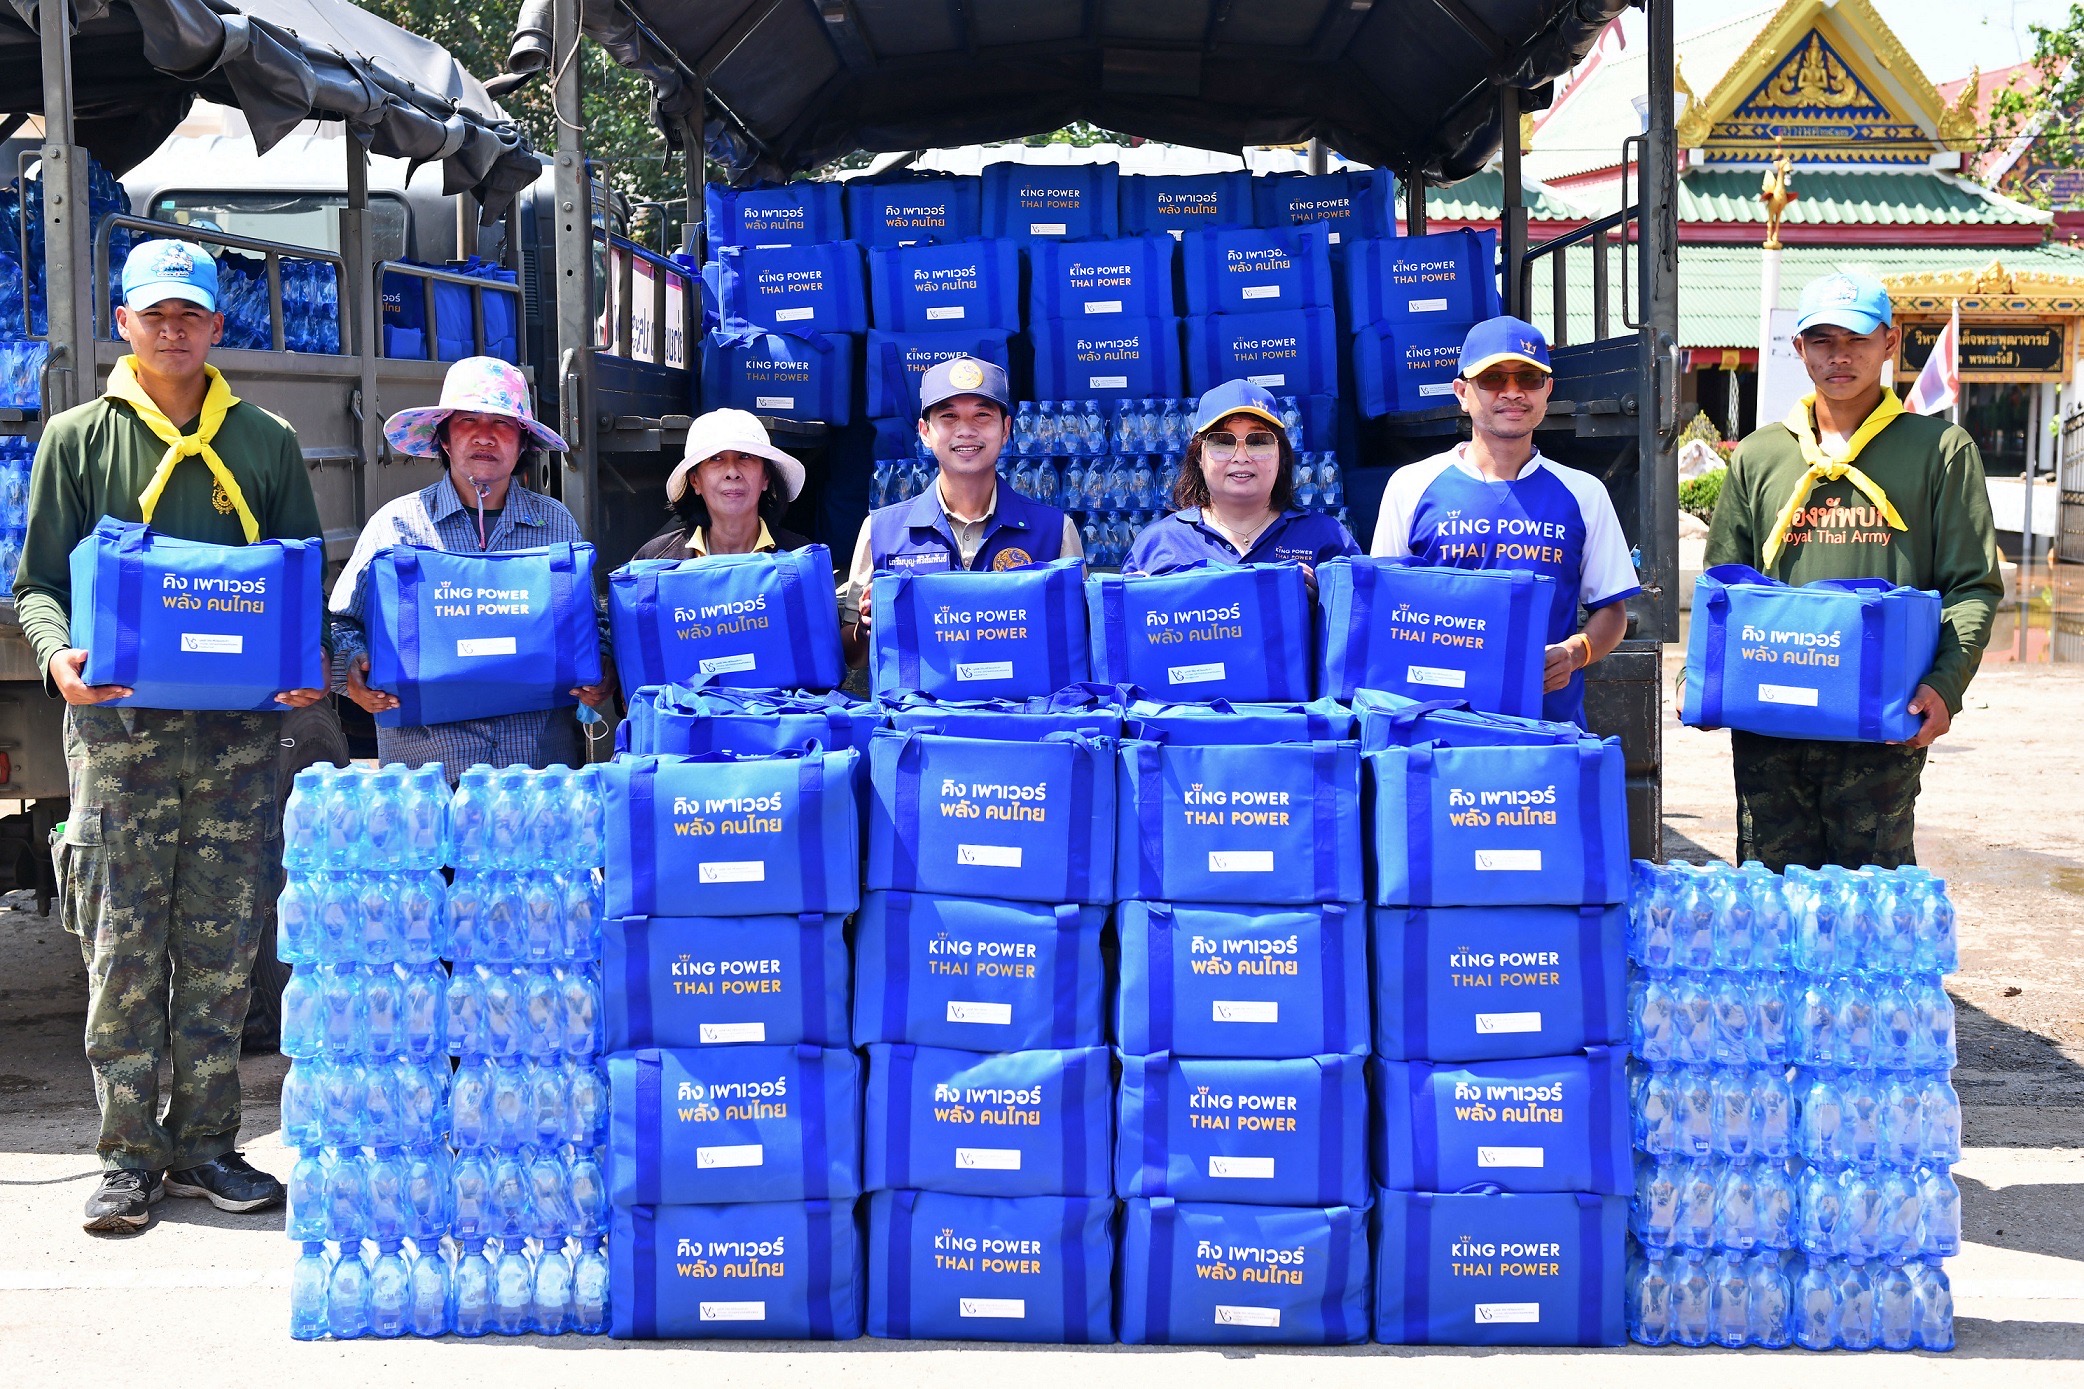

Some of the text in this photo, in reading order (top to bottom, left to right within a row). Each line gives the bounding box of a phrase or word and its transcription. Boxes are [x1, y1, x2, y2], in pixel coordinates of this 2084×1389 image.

[1159, 192, 1217, 202] คิง เพาเวอร์
[745, 207, 803, 217] คิง เพาเวอร์
[886, 205, 944, 215] คิง เพาเวอร์
[1158, 203, 1216, 214] พลัง คนไทย
[745, 219, 803, 229] พลัง คนไทย
[886, 216, 944, 226] พลัง คนไทย
[1228, 249, 1287, 260] คิง เพาเวอ
[914, 265, 976, 280] คิง เพาเวอร์
[1070, 266, 1131, 276] KING POWER
[1229, 259, 1290, 272] พลัง คนไทย
[1393, 261, 1455, 272] KING POWER
[759, 271, 822, 282] KING POWER
[1071, 278, 1131, 287] THAI POWER
[1394, 273, 1455, 284] THAI POWER
[760, 283, 822, 294] THAI POWER
[915, 279, 976, 291] พลัง คนไทย
[1077, 337, 1138, 349] คิง เพาเวอร์
[1233, 338, 1296, 350] KING POWER
[1078, 349, 1139, 361] พลัง คนไทย
[1235, 350, 1296, 361] THAI POWER
[1438, 518, 1566, 540] KING POWER
[1816, 530, 1846, 544] Thai
[1851, 530, 1891, 546] Army
[1439, 543, 1563, 564] THAI POWER
[163, 573, 265, 594] คิง เพาเวอร์
[163, 593, 264, 613] พลัง คนไทย
[435, 589, 529, 602] KING POWER
[434, 603, 529, 616] THAI POWER
[675, 593, 766, 622] คิง เพาเวอร์
[1147, 603, 1240, 626] คิง เพาเวอร์
[934, 609, 1026, 624] KING POWER
[1392, 610, 1486, 630] KING POWER
[677, 616, 768, 640] พลัง คนไทย
[935, 628, 1027, 642] THAI POWER
[1148, 623, 1241, 644] พลัง คนไทย
[1742, 625, 1841, 647] คิง เพาเวอร์
[1391, 628, 1483, 649] THAI POWER
[1742, 645, 1839, 666] พลัง คนไทย
[942, 779, 1046, 800] คิง เพาเวอร์
[1450, 785, 1556, 806] คิง เพาเวอร์
[674, 792, 781, 814] คิง เพาเวอร์
[1185, 791, 1289, 805] KING POWER
[940, 799, 1045, 821] พลัง คนไทย
[1185, 811, 1289, 825] THAI POWER
[1449, 806, 1556, 826] พลัง คนไทย
[674, 814, 781, 835] พลัง คนไทย
[929, 941, 1036, 958] KING POWER
[1192, 935, 1297, 954] คิง เพาเวอร์
[672, 960, 780, 975] KING POWER
[1191, 955, 1297, 975] พลัง คนไทย
[1451, 952, 1559, 967] KING POWER
[929, 961, 1035, 978] THAI POWER
[673, 980, 781, 994] THAI POWER
[1452, 972, 1559, 986] THAI POWER
[678, 1077, 786, 1100] คิง เพาเวอร์
[935, 1084, 1041, 1104] คิง เพาเวอร์
[1455, 1082, 1562, 1101] คิง เพาเวอร์
[1190, 1094, 1296, 1110] KING POWER
[678, 1099, 786, 1122] พลัง คนไทย
[934, 1105, 1040, 1125] พลัง คนไทย
[1455, 1102, 1562, 1122] พลัง คนไทย
[1190, 1115, 1296, 1131] THAI POWER
[677, 1237, 784, 1256] คิง เพาเวอร์
[935, 1236, 1040, 1254] KING POWER
[1197, 1241, 1304, 1264] คิง เพาเวอร์
[1452, 1244, 1559, 1257] KING POWER
[677, 1258, 784, 1277] พลัง คนไทย
[935, 1255, 1040, 1273] THAI POWER
[1452, 1263, 1559, 1276] THAI POWER
[1196, 1261, 1302, 1284] พลัง คนไทย
